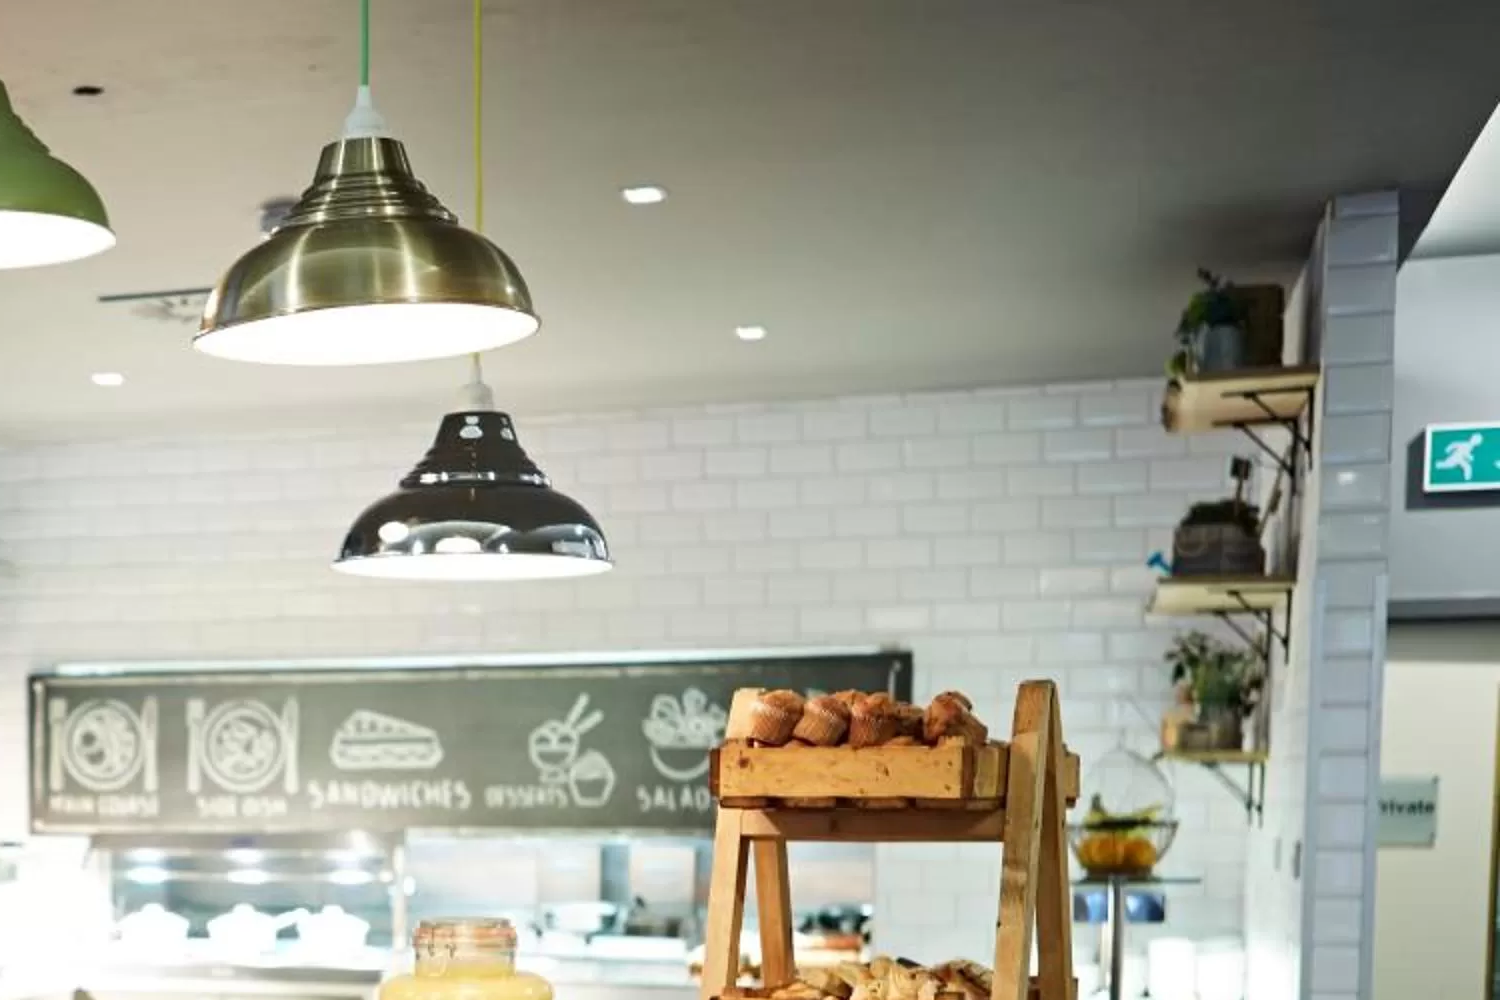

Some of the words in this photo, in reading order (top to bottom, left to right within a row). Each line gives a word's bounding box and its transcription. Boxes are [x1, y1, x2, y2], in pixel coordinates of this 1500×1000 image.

[307, 779, 472, 810] SANDWICHES
[484, 784, 569, 809] DESSERTS
[635, 783, 713, 812] SALAD
[1378, 798, 1436, 816] rivate
